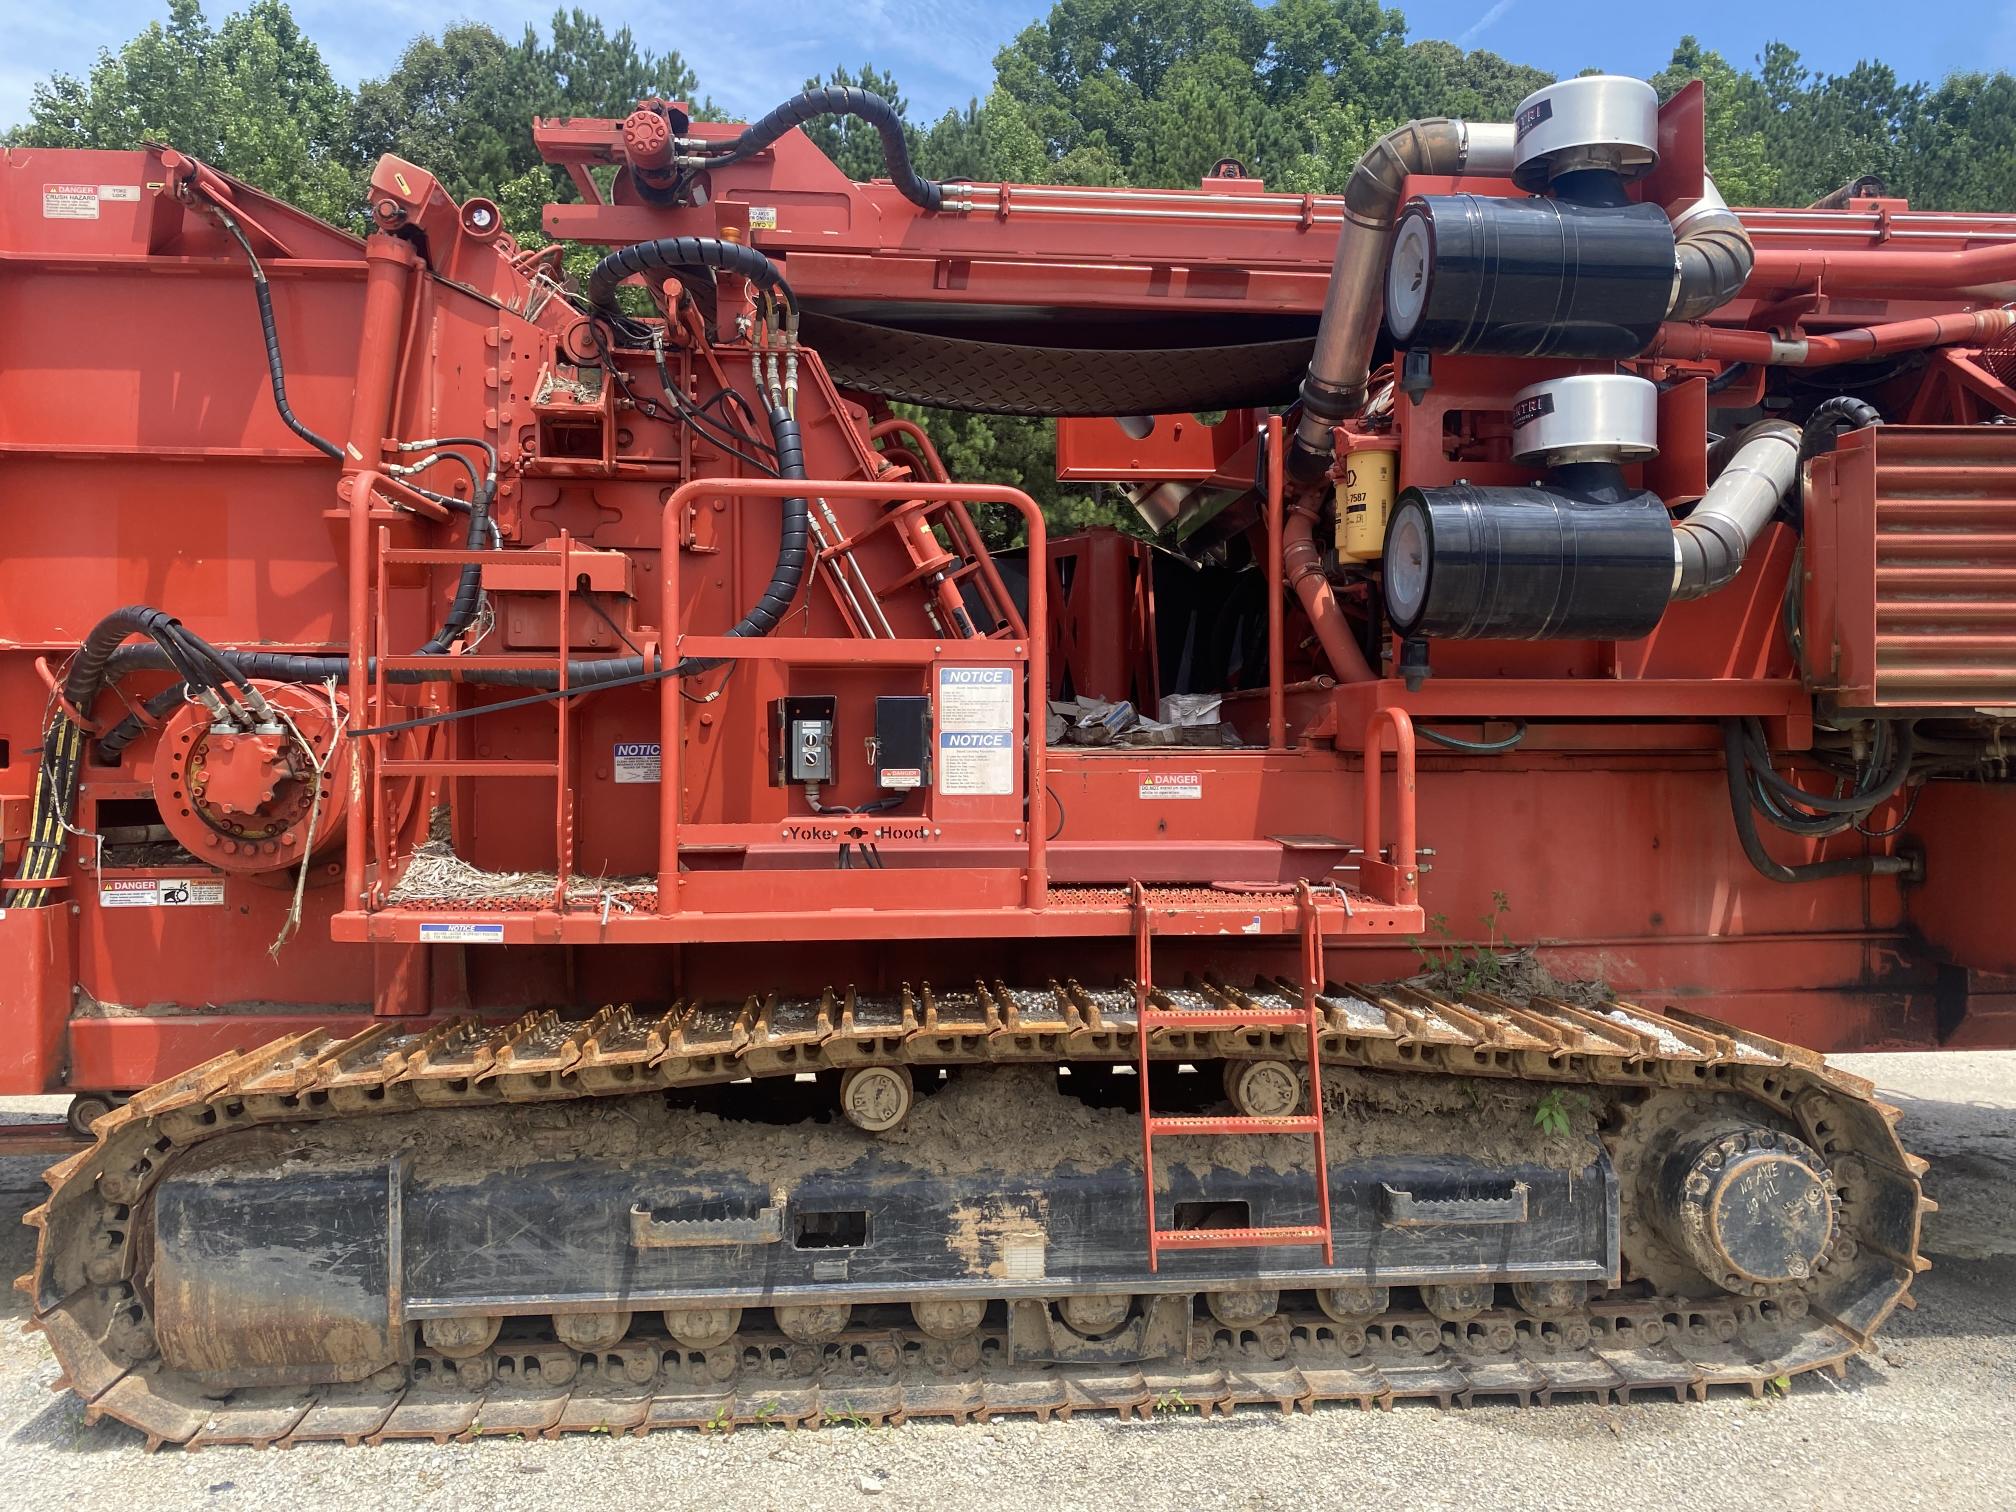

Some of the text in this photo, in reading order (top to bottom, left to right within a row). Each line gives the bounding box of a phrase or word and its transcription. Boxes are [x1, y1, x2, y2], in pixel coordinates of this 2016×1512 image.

[58, 186, 93, 194] DANGER
[949, 671, 1004, 683] NOTICE
[949, 734, 1004, 746] NOTICE
[618, 744, 661, 756] NOTIC
[1155, 775, 1198, 784] DANGER
[788, 825, 924, 840] Yoke Hood
[114, 881, 156, 890] DANGER
[447, 924, 476, 932] NOTICE
